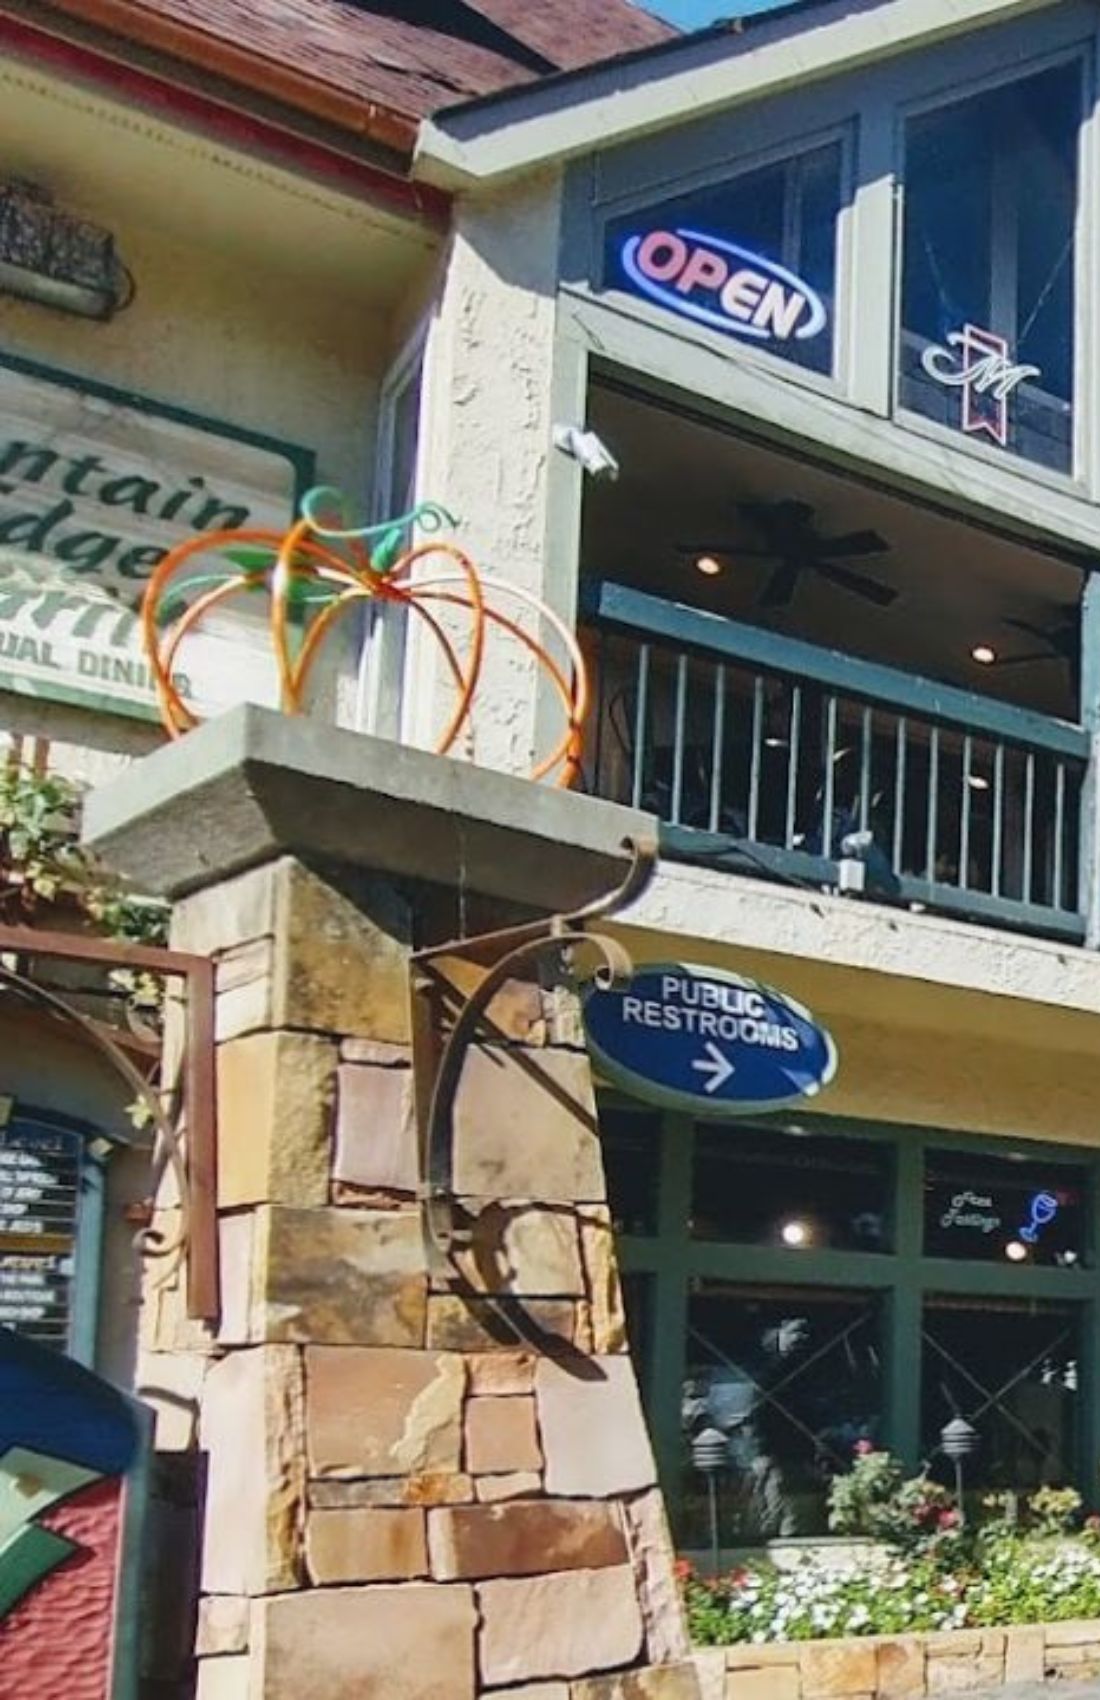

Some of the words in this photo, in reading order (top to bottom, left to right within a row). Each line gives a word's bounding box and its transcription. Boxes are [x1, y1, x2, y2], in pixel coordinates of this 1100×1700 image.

[638, 231, 805, 340] OPEN
[0, 485, 168, 579] dge
[622, 997, 799, 1051] RESTROOMS
[662, 975, 766, 1018] PUBLIC
